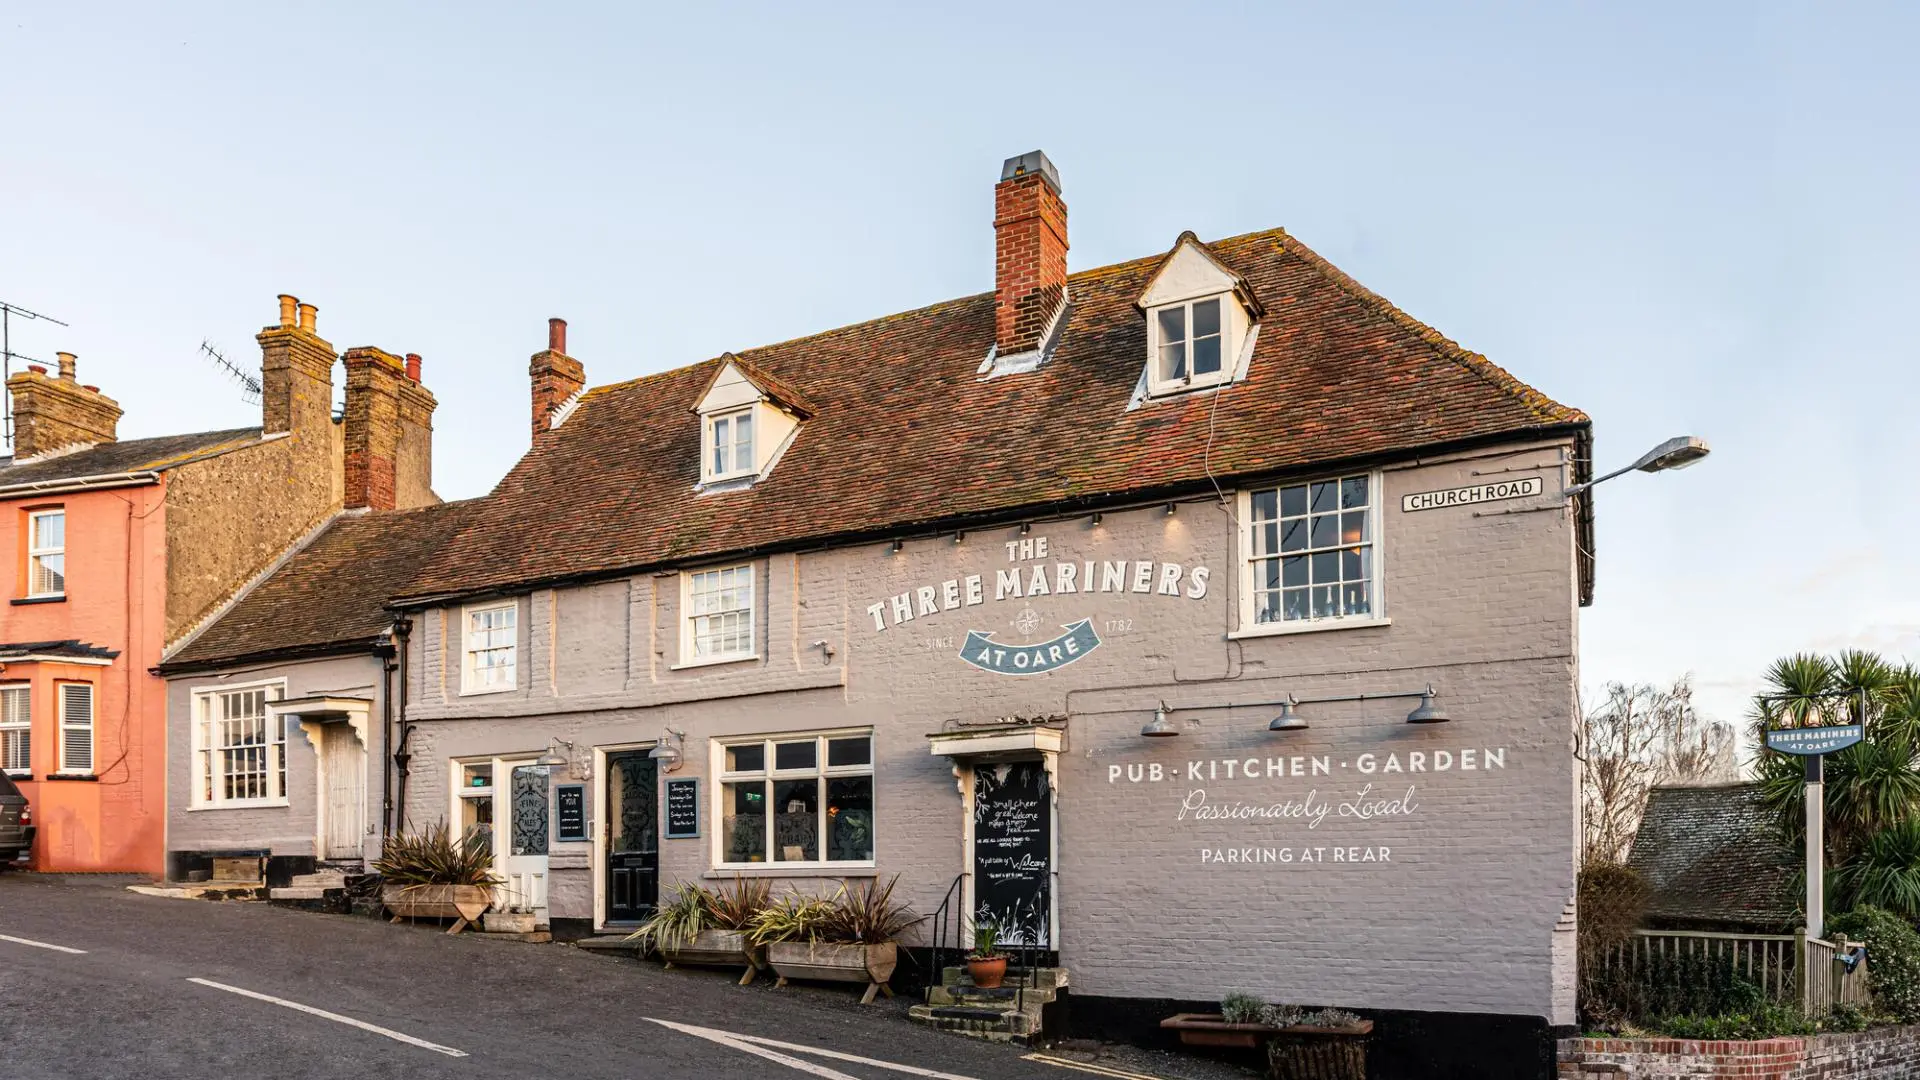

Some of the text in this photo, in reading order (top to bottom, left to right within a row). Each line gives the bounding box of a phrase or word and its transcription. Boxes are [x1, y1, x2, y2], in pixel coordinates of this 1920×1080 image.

[1411, 481, 1532, 508] CHURCH ROAD
[1006, 537, 1048, 562] THE
[867, 560, 1210, 631] THREE MARINERS
[926, 619, 1133, 650] SINCE 1782
[977, 636, 1080, 669] AT OARE
[1770, 728, 1860, 742] THREE MARINERS
[1790, 740, 1837, 750] AT OARE
[1107, 748, 1506, 784] PUB KITCHEN GARDEN
[1177, 783, 1419, 829] Passionately Local
[1201, 847, 1391, 863] PARKING AT REAR
